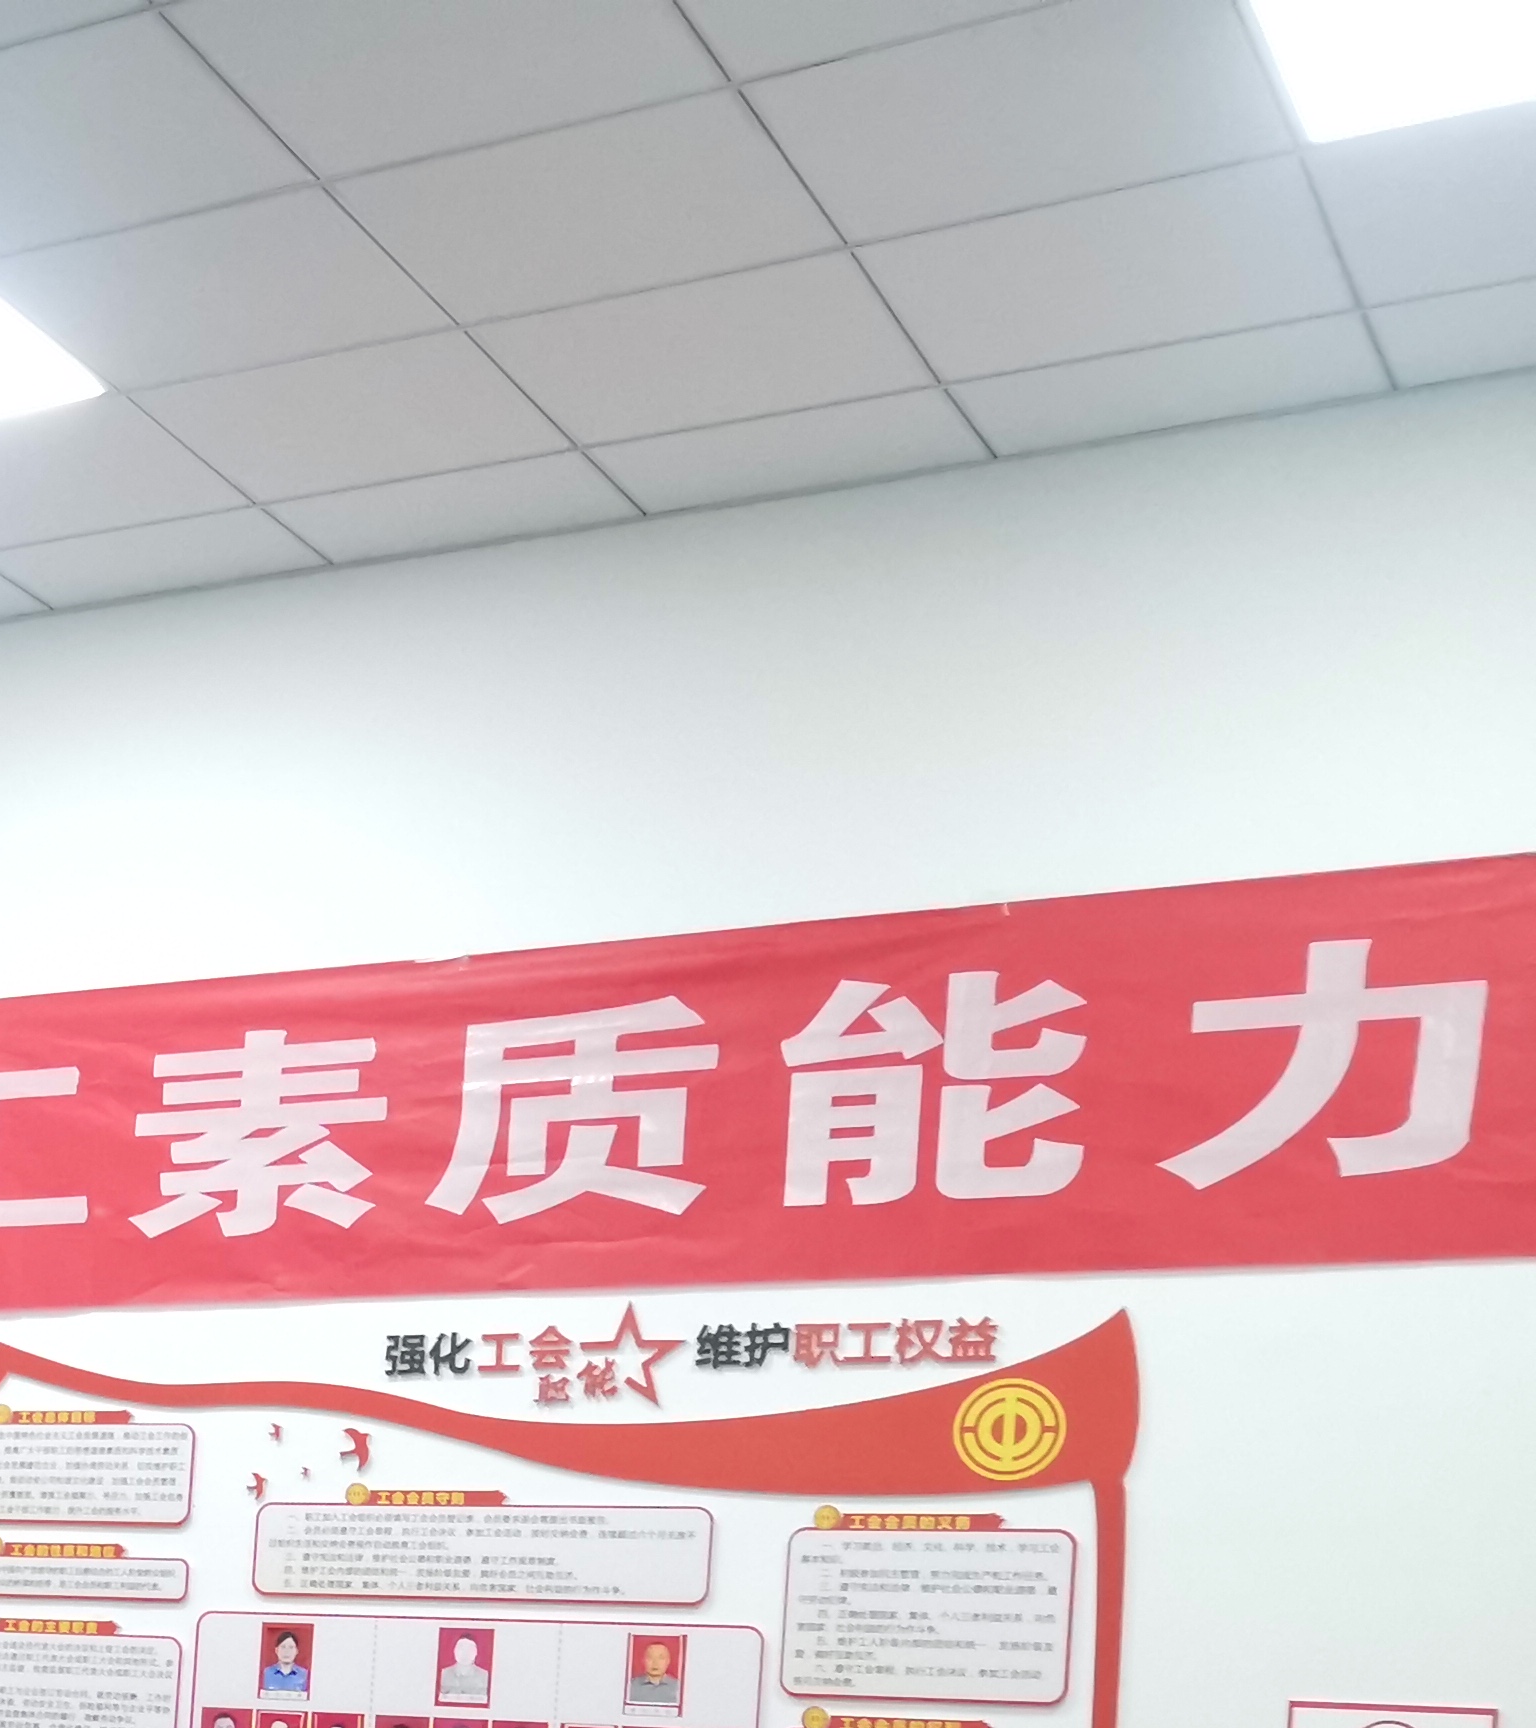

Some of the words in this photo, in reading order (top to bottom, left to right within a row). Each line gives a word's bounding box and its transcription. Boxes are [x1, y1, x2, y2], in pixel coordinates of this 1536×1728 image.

[385, 1325, 573, 1377] 强化工会
[695, 1316, 1000, 1369] 维护职工权益
